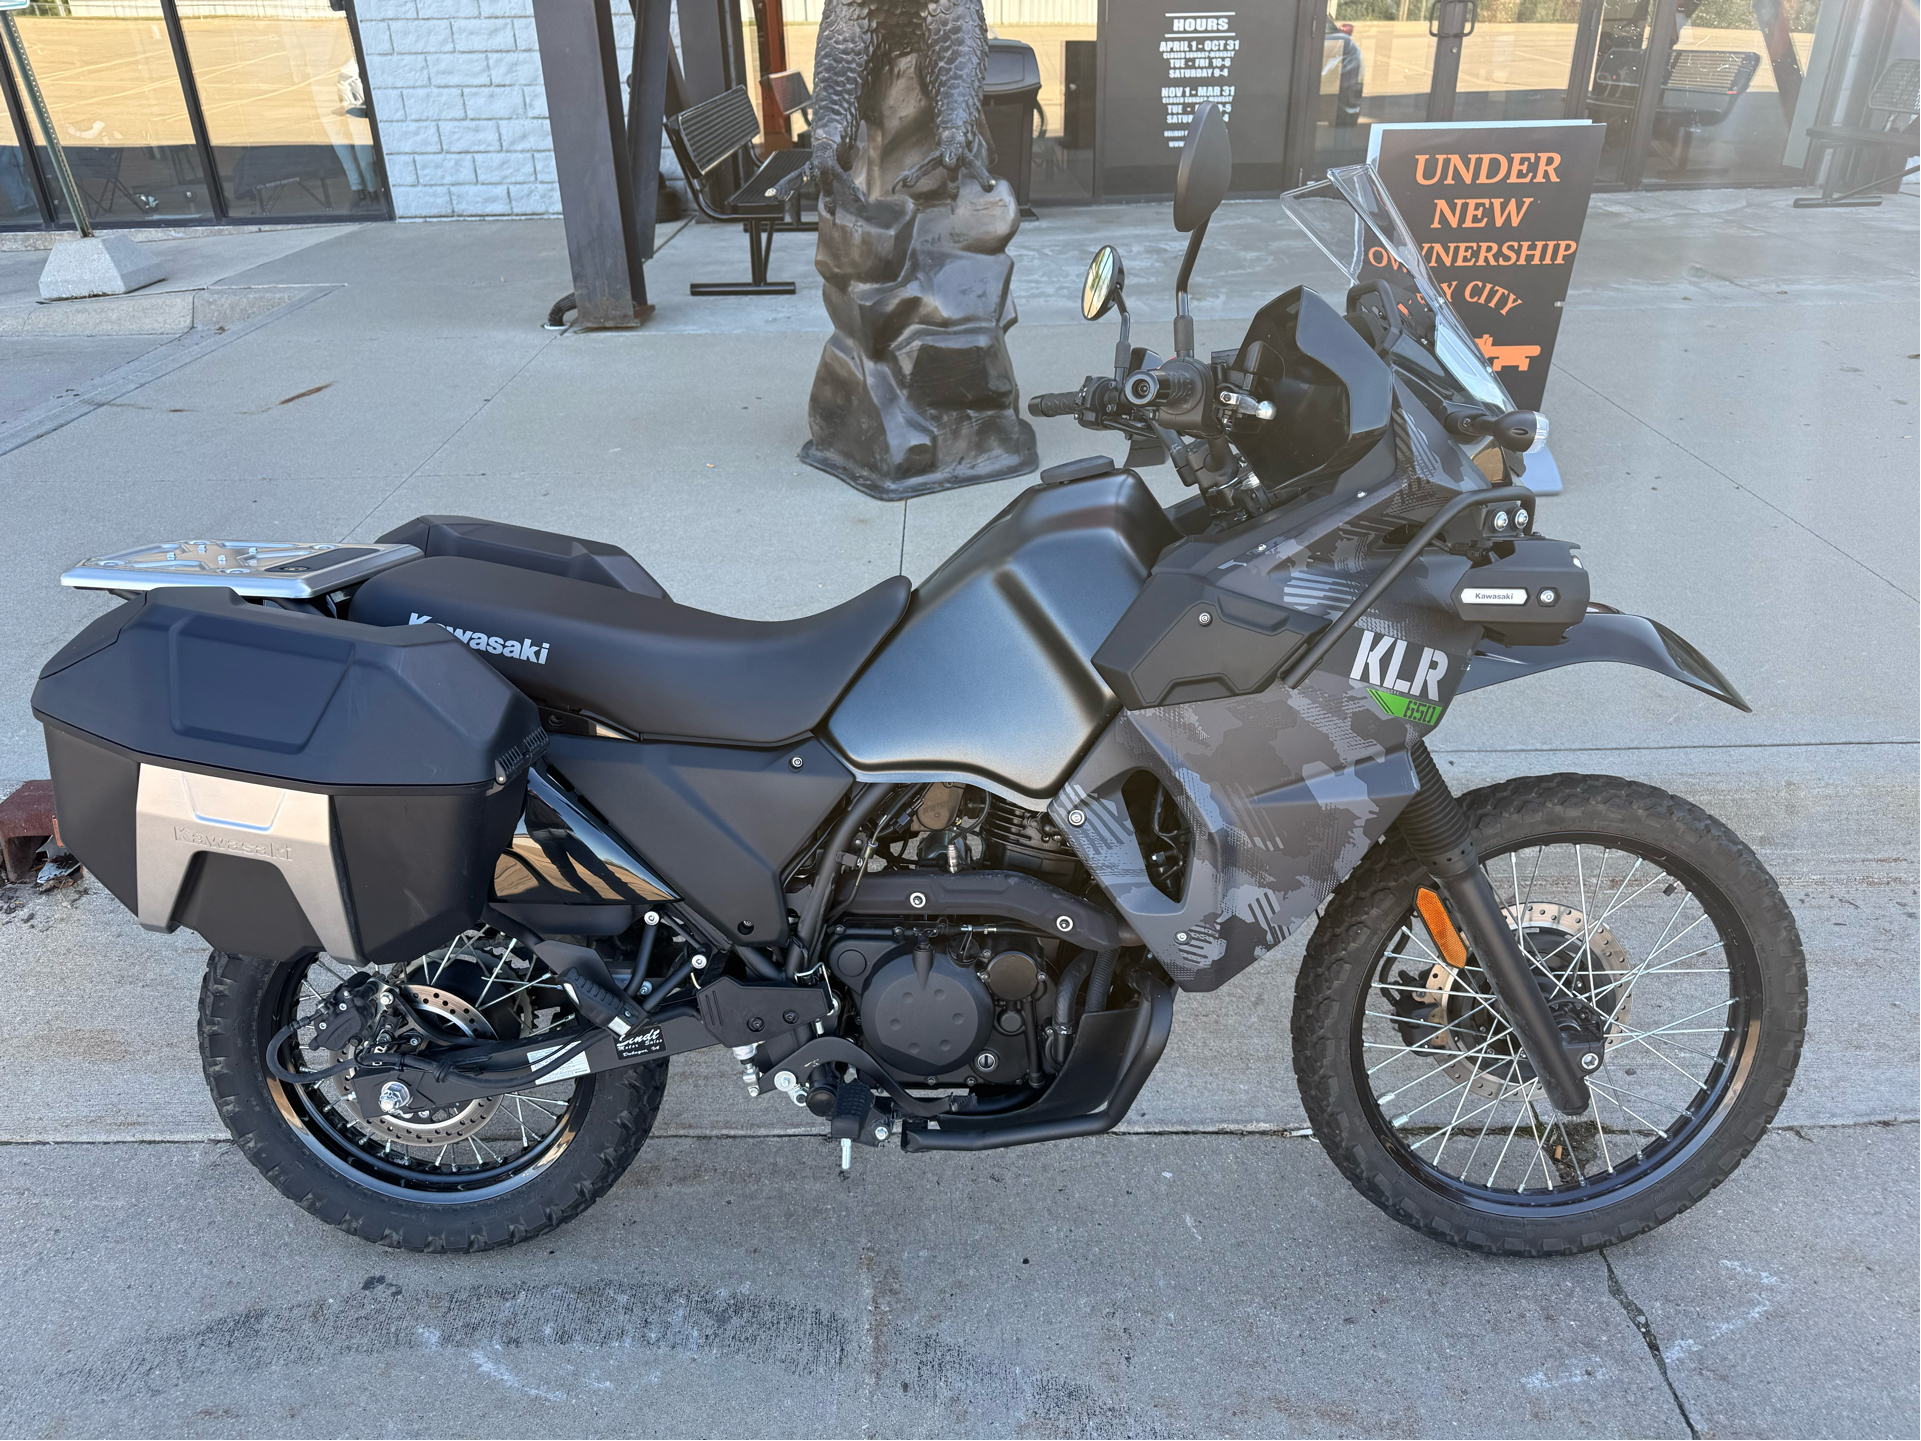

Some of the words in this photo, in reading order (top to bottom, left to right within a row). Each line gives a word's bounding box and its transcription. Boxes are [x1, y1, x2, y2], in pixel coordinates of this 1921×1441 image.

[1173, 18, 1229, 31] HOURS
[1159, 41, 1190, 52] APRIL
[1190, 40, 1197, 51] 1
[1204, 40, 1226, 51] OCT
[1226, 39, 1240, 51] 31
[1169, 58, 1186, 68] TUE
[1195, 58, 1209, 68] FRI
[1211, 57, 1232, 67] 10-6
[1168, 69, 1213, 78] SATURDAY
[1213, 68, 1229, 77] 9-4
[1161, 87, 1184, 98] NOV
[1184, 86, 1191, 97] 1
[1197, 86, 1221, 97] MAR
[1222, 85, 1236, 96] 31
[1167, 104, 1184, 114] TUE
[1415, 153, 1561, 185] UNDER
[1430, 197, 1534, 228] NEW
[1464, 281, 1523, 316] CITY
[1474, 592, 1514, 601] Kawasaki
[408, 612, 550, 665] Kwasaki
[1350, 630, 1449, 701] KLR
[1403, 700, 1437, 724] 650
[173, 826, 293, 862] Kawasaki
